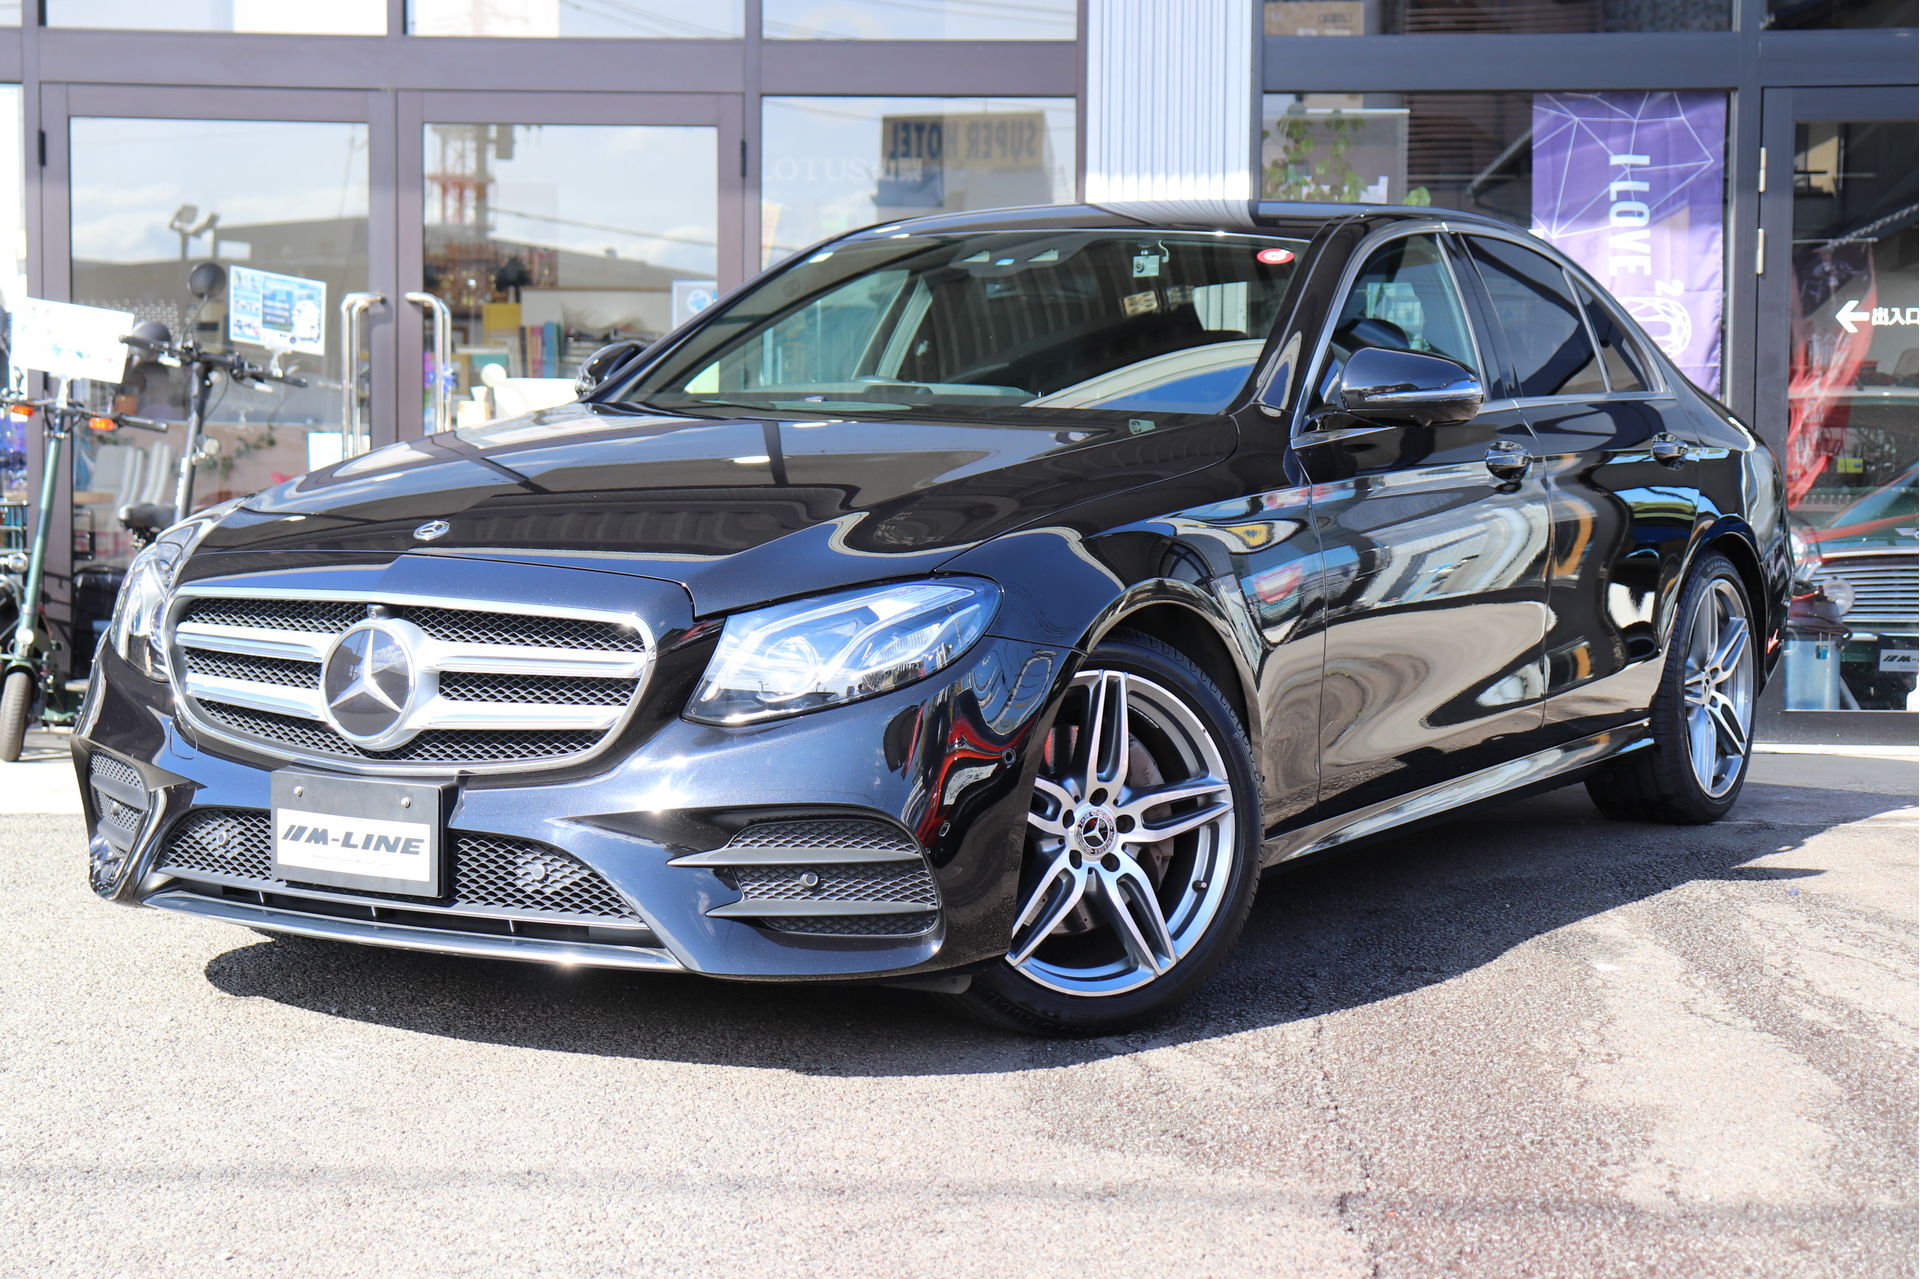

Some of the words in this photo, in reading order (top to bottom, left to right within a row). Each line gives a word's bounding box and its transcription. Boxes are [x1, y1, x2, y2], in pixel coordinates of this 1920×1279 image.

[1608, 181, 1652, 277] LOVE
[1871, 306, 1919, 326] 出入口
